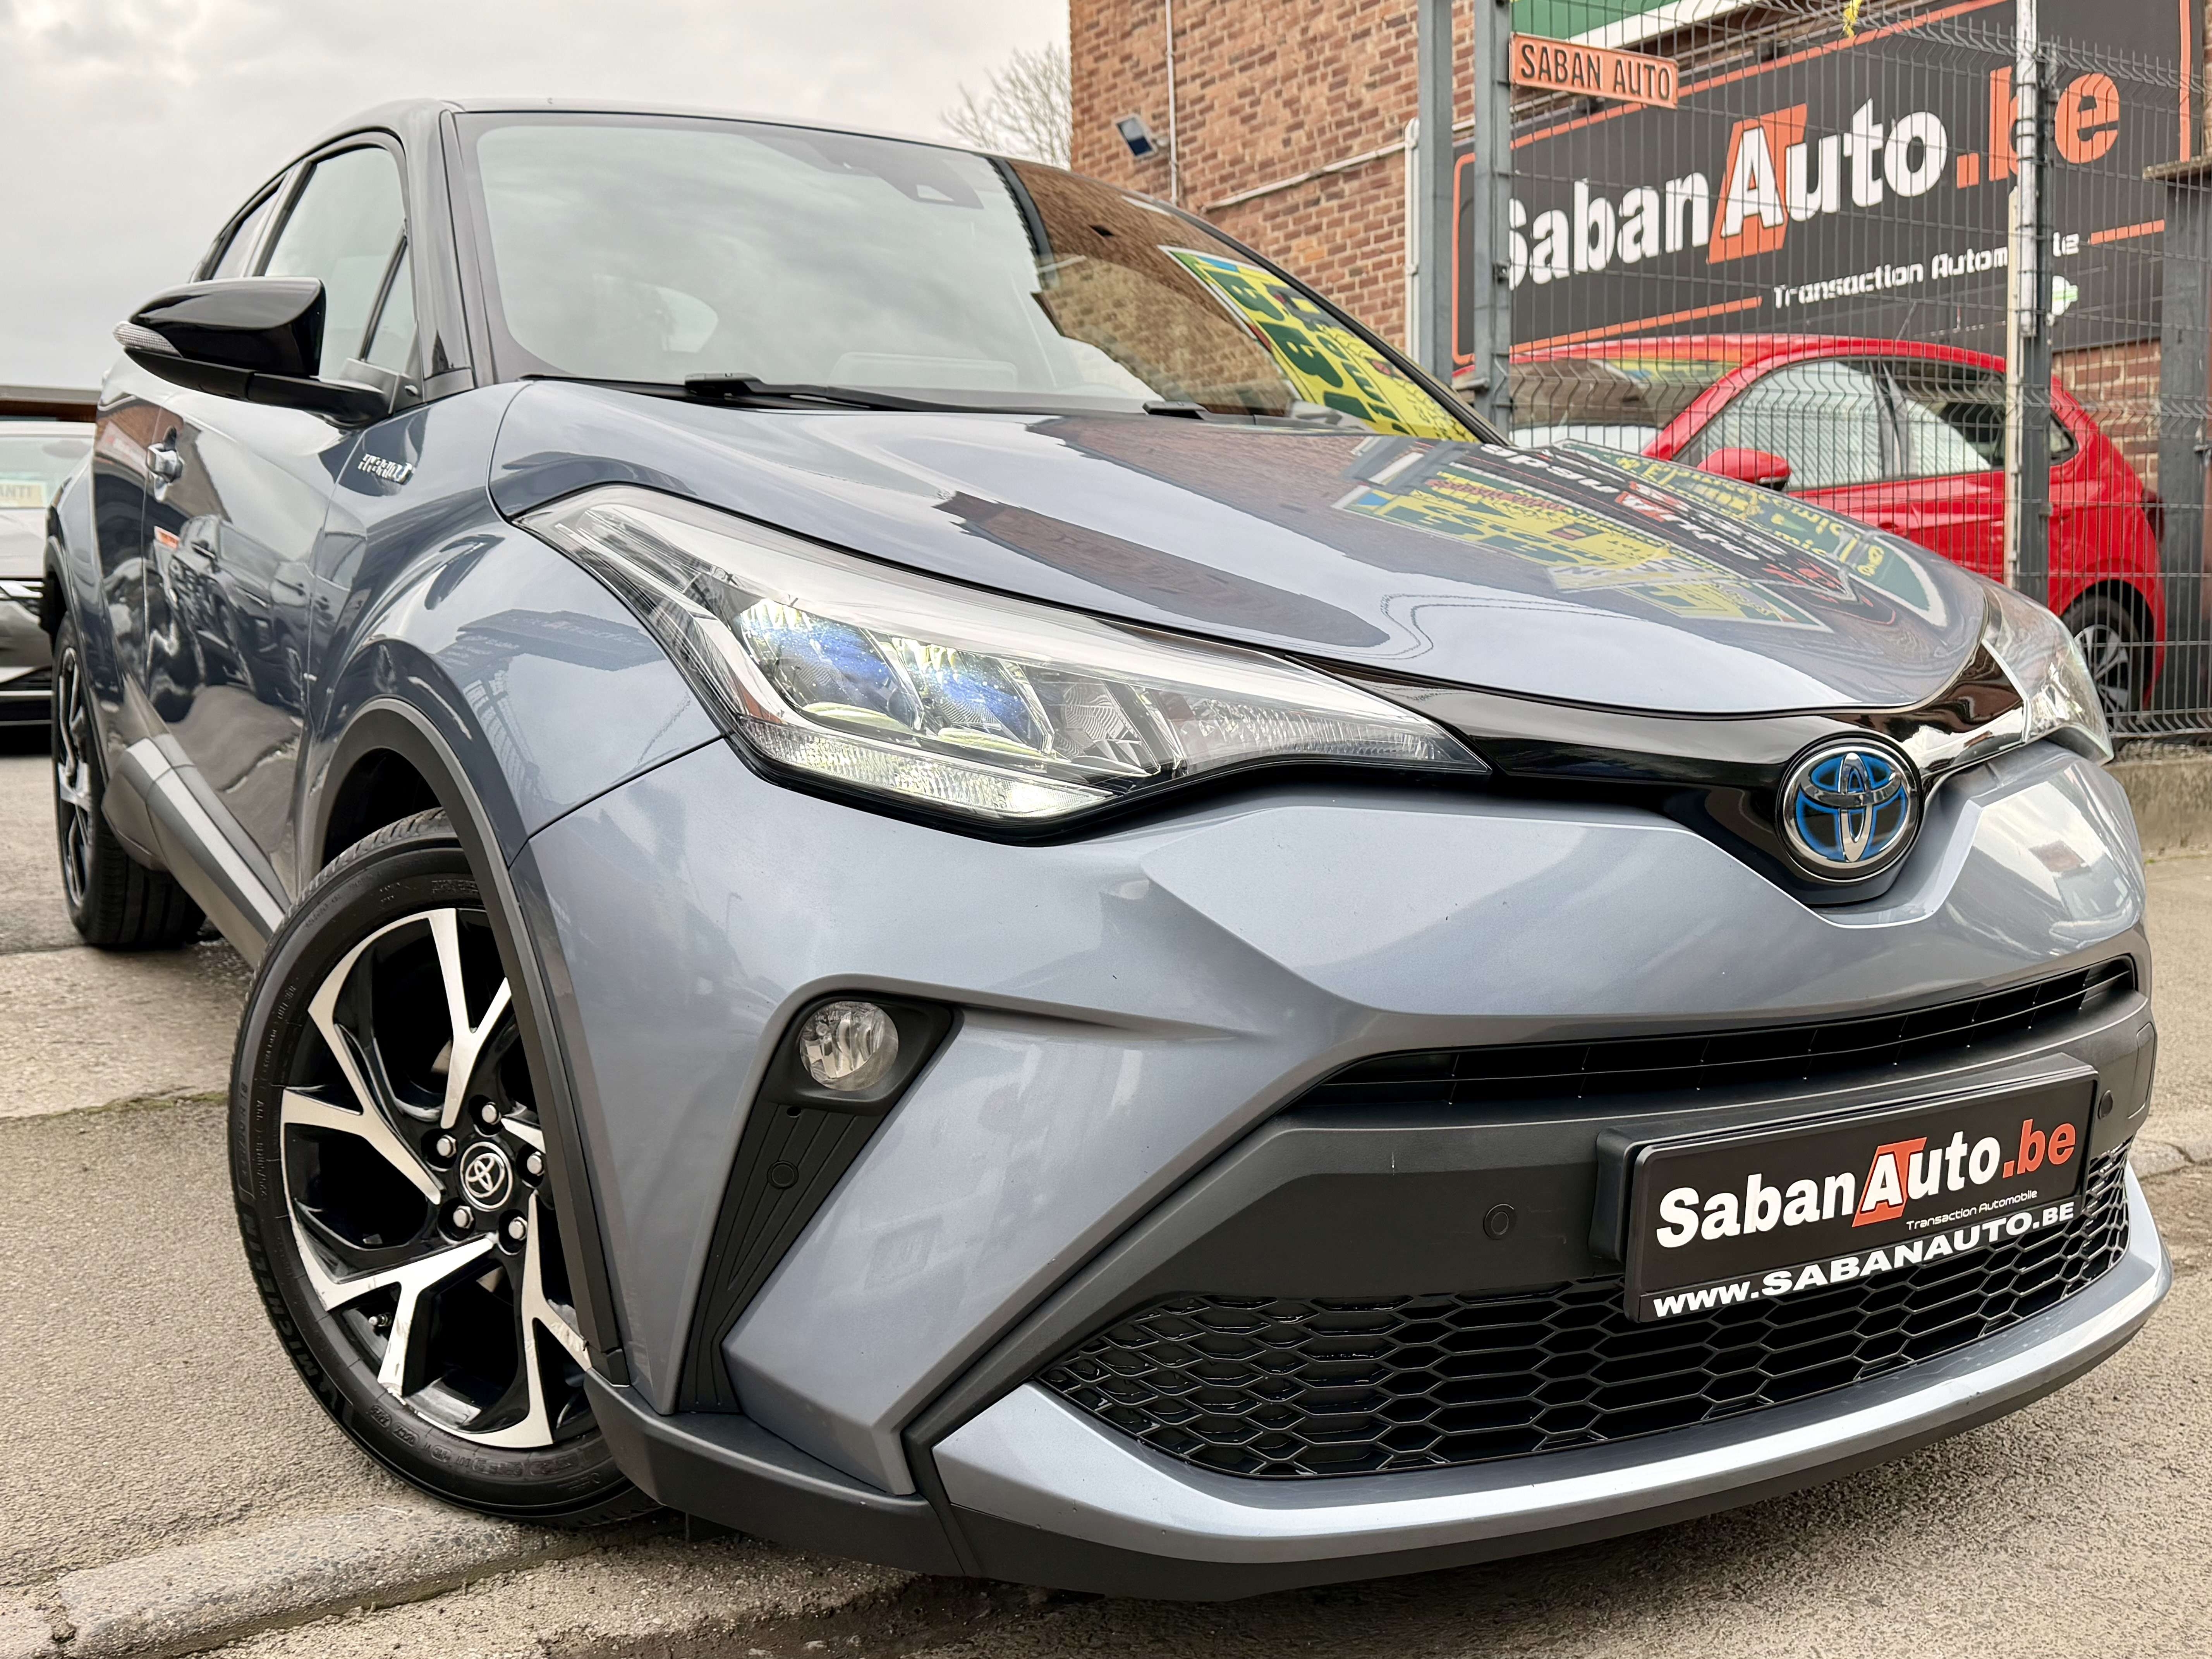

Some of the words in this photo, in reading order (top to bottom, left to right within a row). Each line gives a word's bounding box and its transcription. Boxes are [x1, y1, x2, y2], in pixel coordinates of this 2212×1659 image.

[1521, 45, 1602, 90] SABAN
[1613, 59, 1670, 101] AUTO
[1774, 263, 1923, 309] Transaction
[1931, 232, 2079, 280] Automle
[1656, 1119, 2076, 1248] SabanAuto.be
[1906, 1207, 1977, 1230] Transaction
[1978, 1190, 2038, 1213] Automobile
[243, 1212, 319, 1377] MICHELIN
